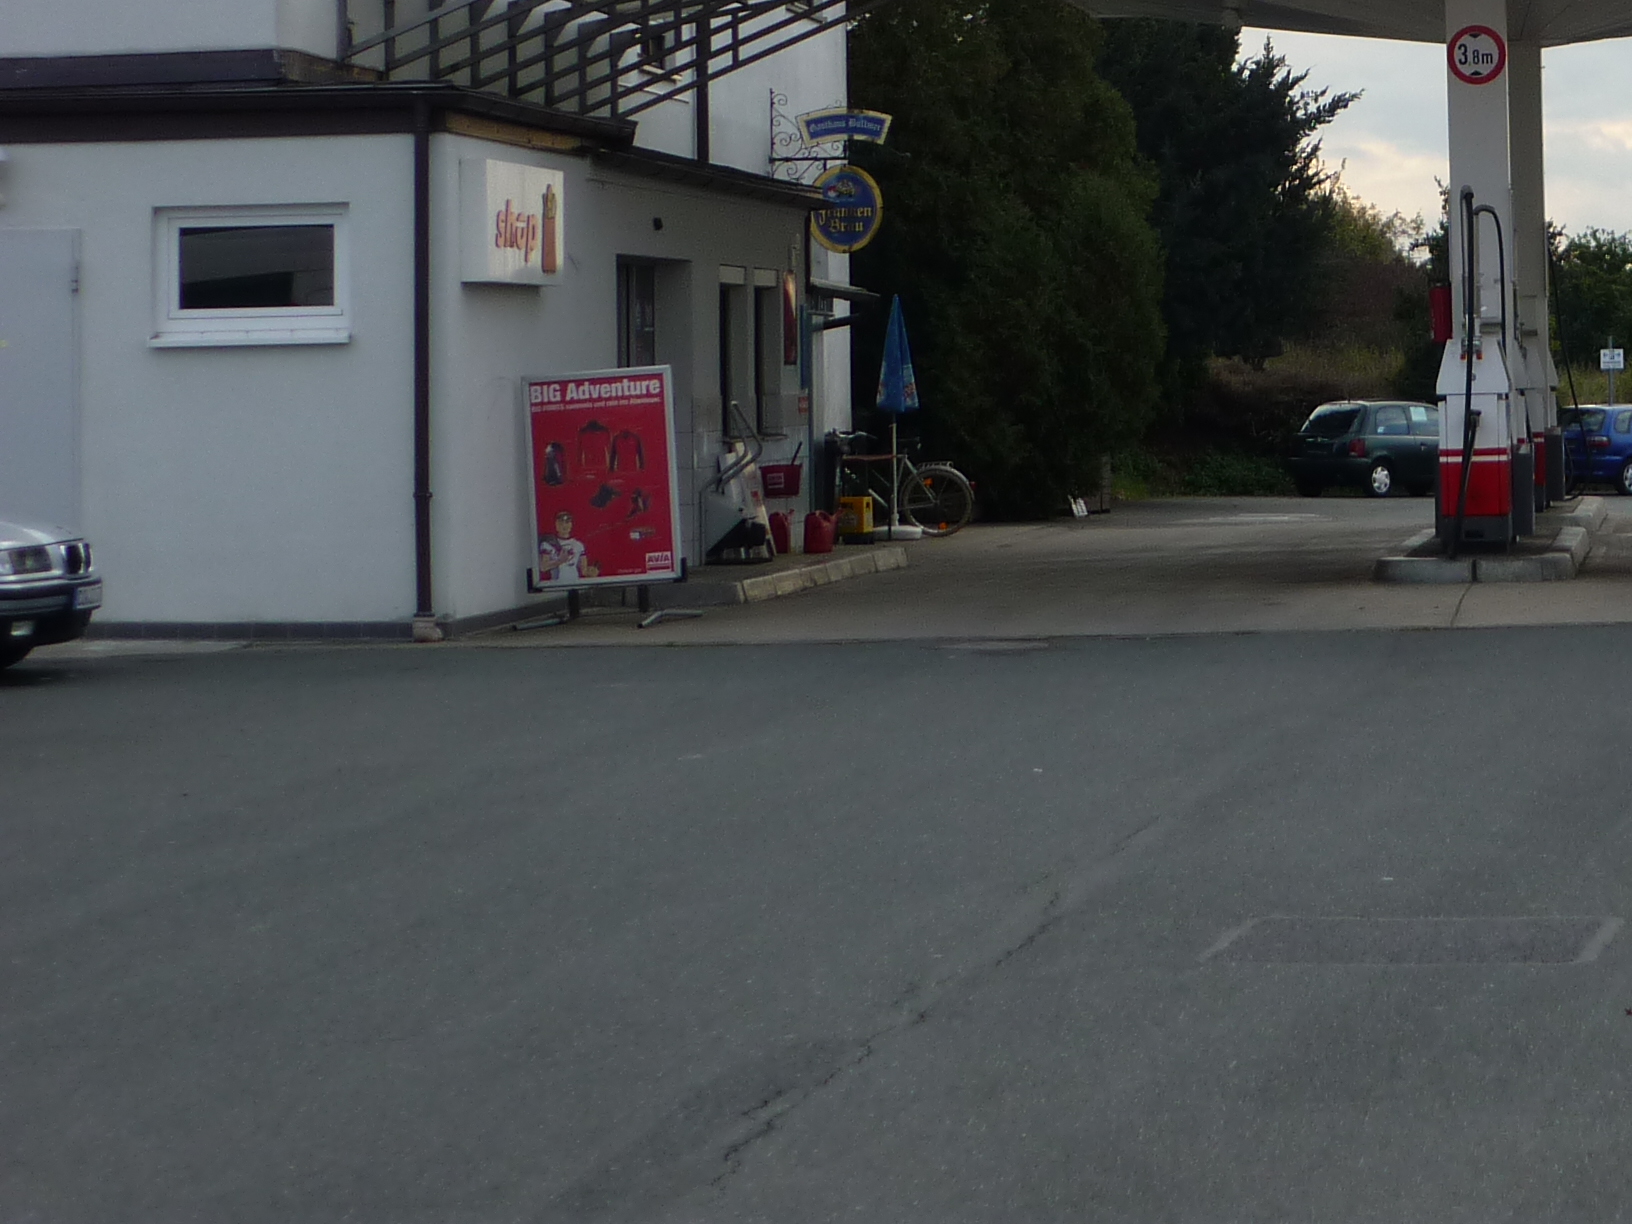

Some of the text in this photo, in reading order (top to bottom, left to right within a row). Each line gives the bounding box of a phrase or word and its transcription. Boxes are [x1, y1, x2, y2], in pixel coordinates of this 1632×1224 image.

[496, 199, 538, 263] shop
[530, 378, 660, 403] BIG Adventure
